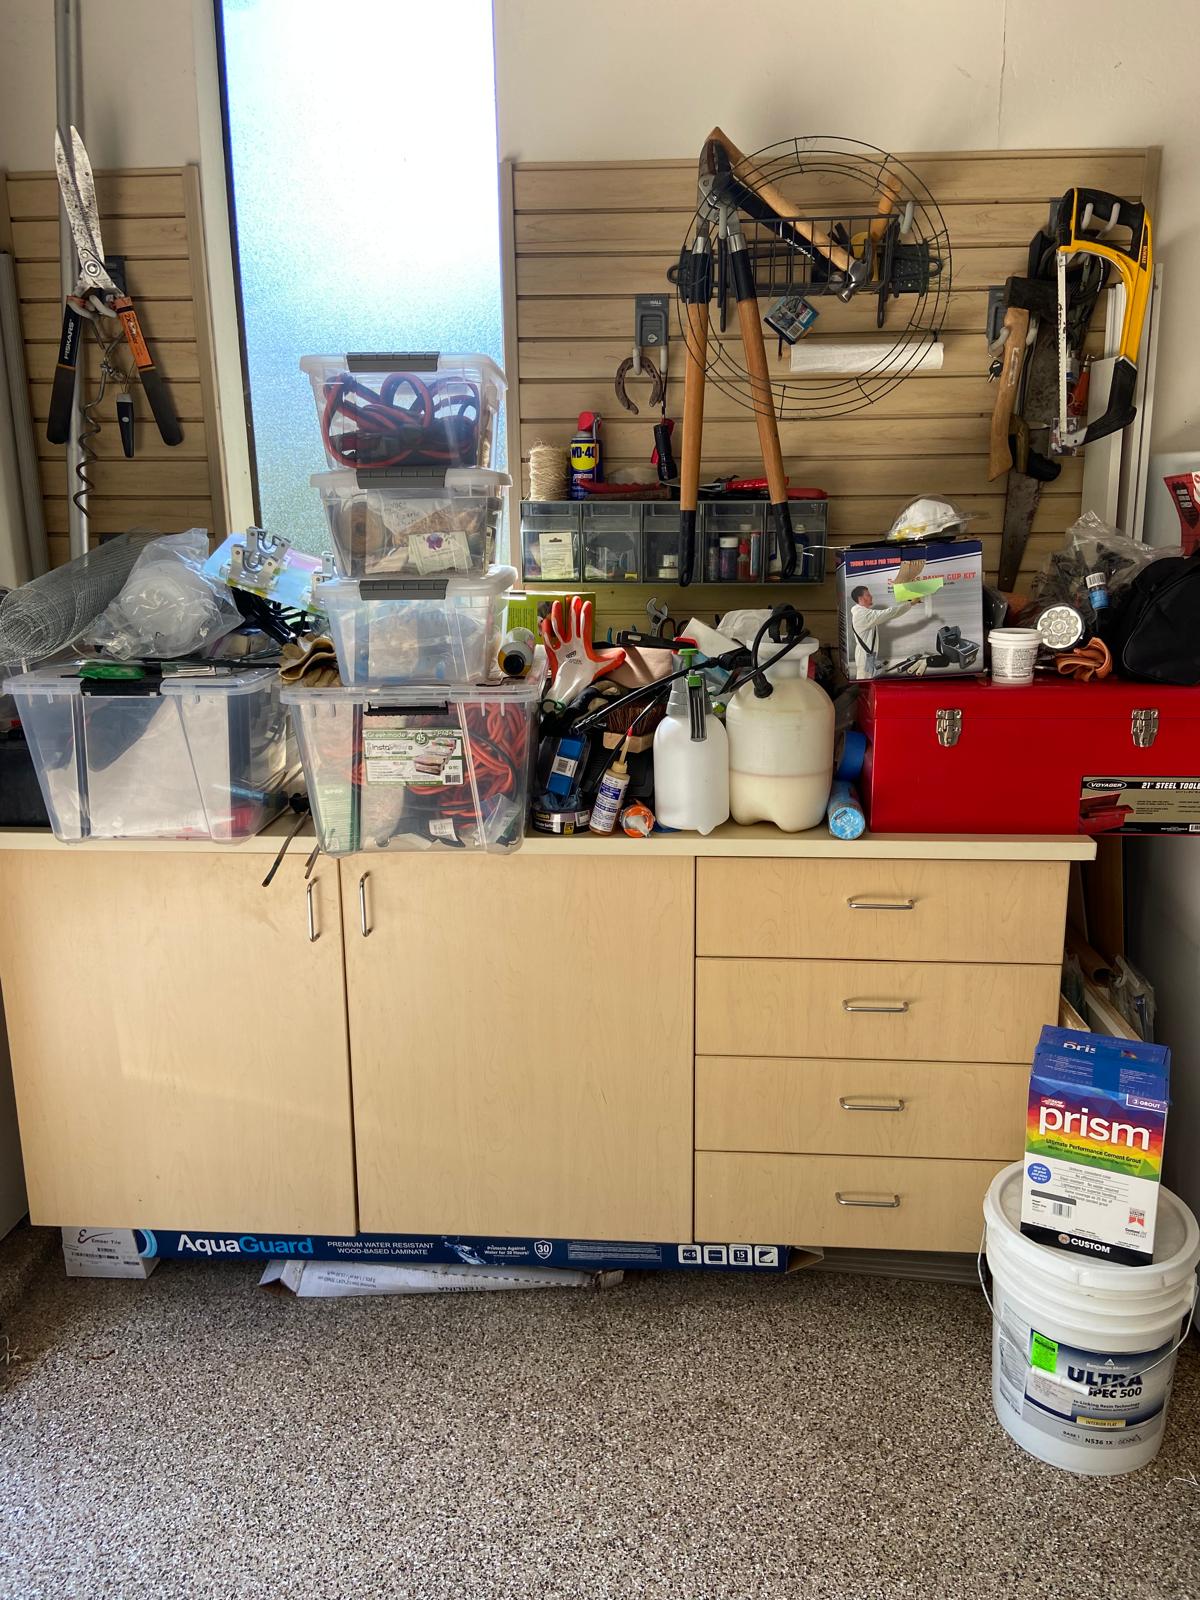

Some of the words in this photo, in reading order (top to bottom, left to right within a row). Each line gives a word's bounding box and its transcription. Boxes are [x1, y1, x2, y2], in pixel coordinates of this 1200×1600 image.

[64, 320, 75, 360] FISKARS
[416, 734, 426, 742] 45
[1139, 1100, 1160, 1109] GROUT
[1039, 1106, 1150, 1150] prism
[1046, 1138, 1068, 1148] Ultimate
[1069, 1144, 1103, 1156] Performance
[1104, 1152, 1125, 1160] Cement
[1126, 1156, 1142, 1165] Grout
[178, 1234, 314, 1256] AquaGuard
[538, 1244, 550, 1252] 30
[1071, 1238, 1110, 1254] CUSTOM
[1068, 1366, 1142, 1388] ULTRA
[1120, 1387, 1142, 1398] 500
